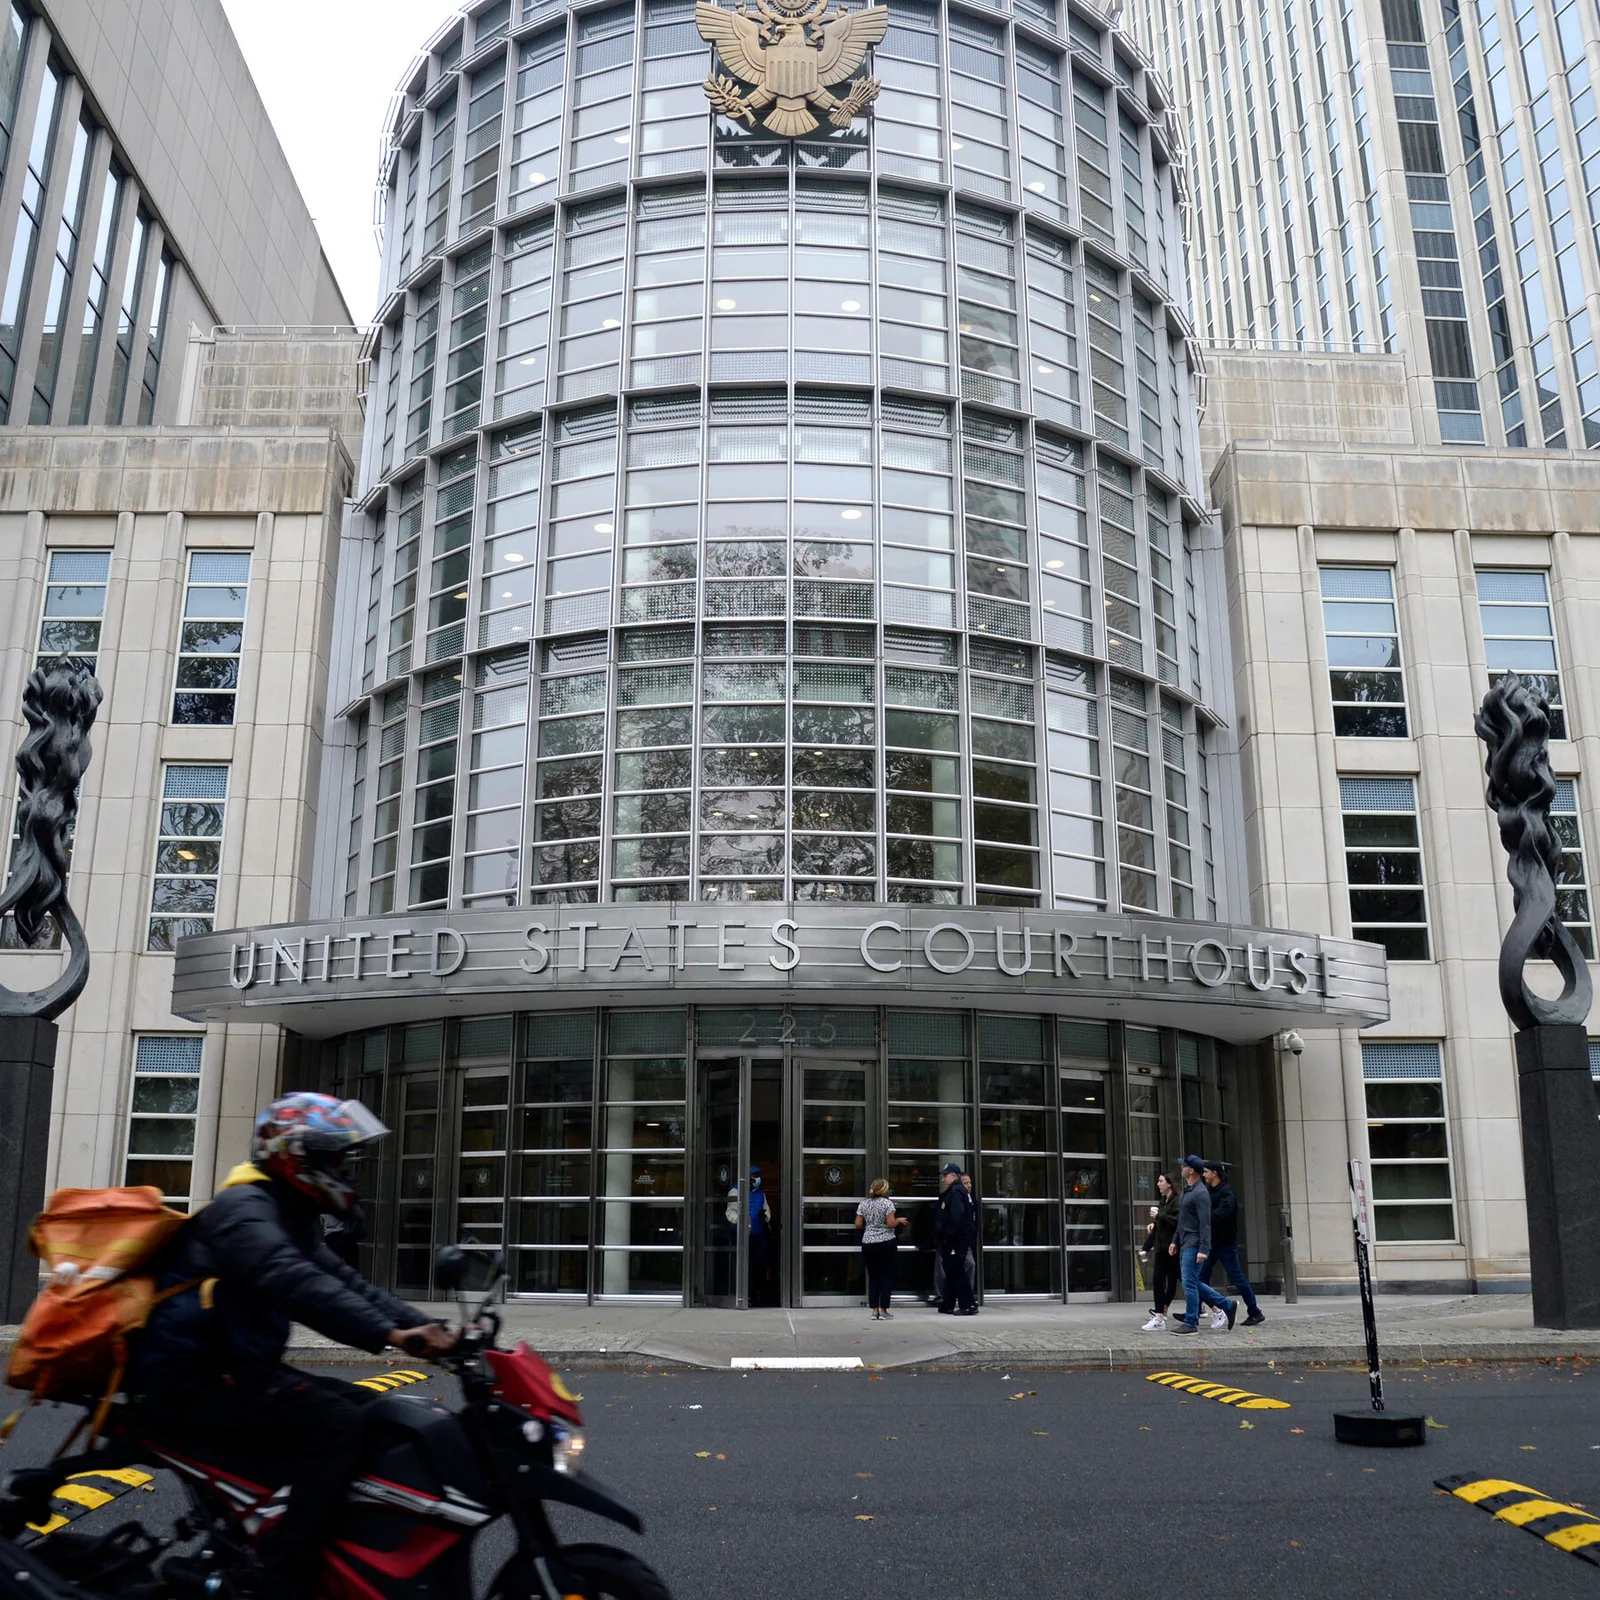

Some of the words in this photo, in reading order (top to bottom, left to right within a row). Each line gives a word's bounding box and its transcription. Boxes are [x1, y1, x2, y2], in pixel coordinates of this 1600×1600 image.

[229, 927, 466, 989] UNITED
[518, 919, 800, 974] STATES
[860, 920, 1341, 998] COURTHOUSE
[738, 1014, 837, 1043] 225
